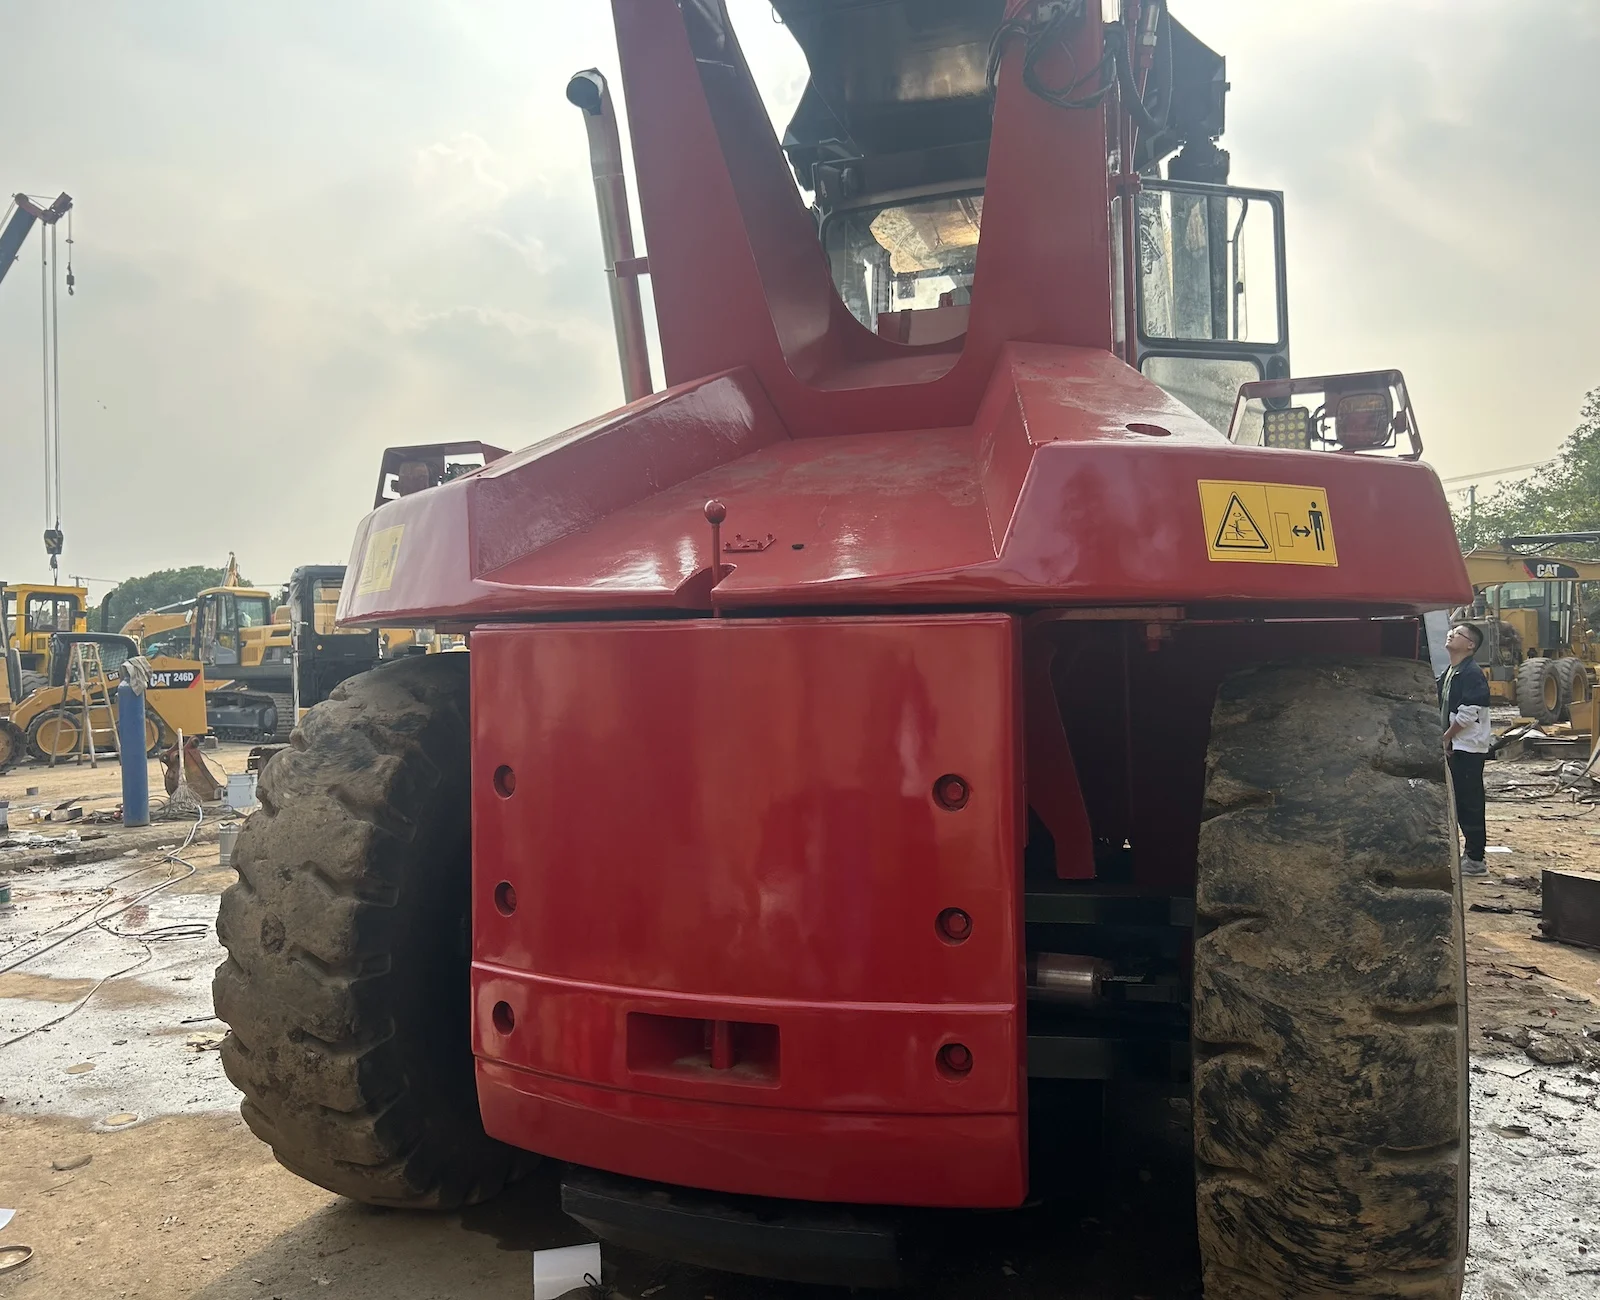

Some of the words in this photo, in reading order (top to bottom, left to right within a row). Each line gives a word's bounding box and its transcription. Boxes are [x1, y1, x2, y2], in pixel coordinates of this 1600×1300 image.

[1536, 564, 1560, 578] CAT
[150, 672, 171, 687] CAT
[173, 672, 194, 682] 246D
